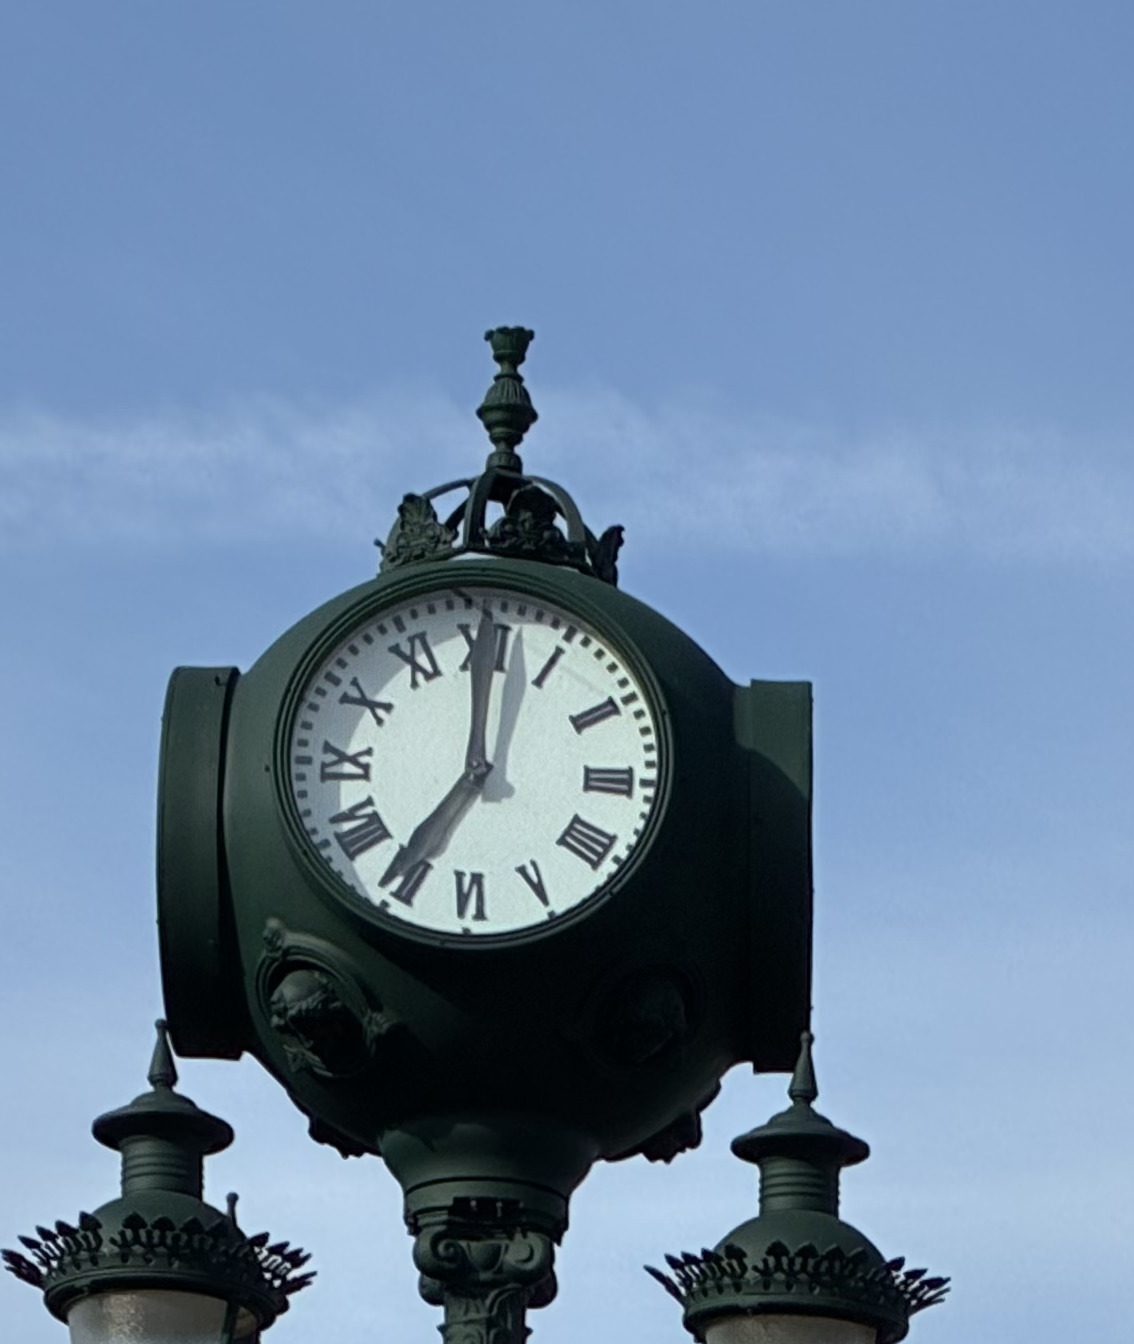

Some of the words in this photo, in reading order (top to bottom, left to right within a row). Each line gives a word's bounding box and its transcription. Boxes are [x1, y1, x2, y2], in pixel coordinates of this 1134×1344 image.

[388, 631, 442, 690] XI
[531, 645, 565, 689] I
[339, 676, 394, 727] X
[568, 696, 621, 735] II
[321, 740, 373, 783] IX
[583, 765, 633, 800] III
[329, 795, 393, 861] VIII
[555, 813, 617, 871] IIII
[454, 870, 487, 921] VI
[515, 859, 549, 907] V
